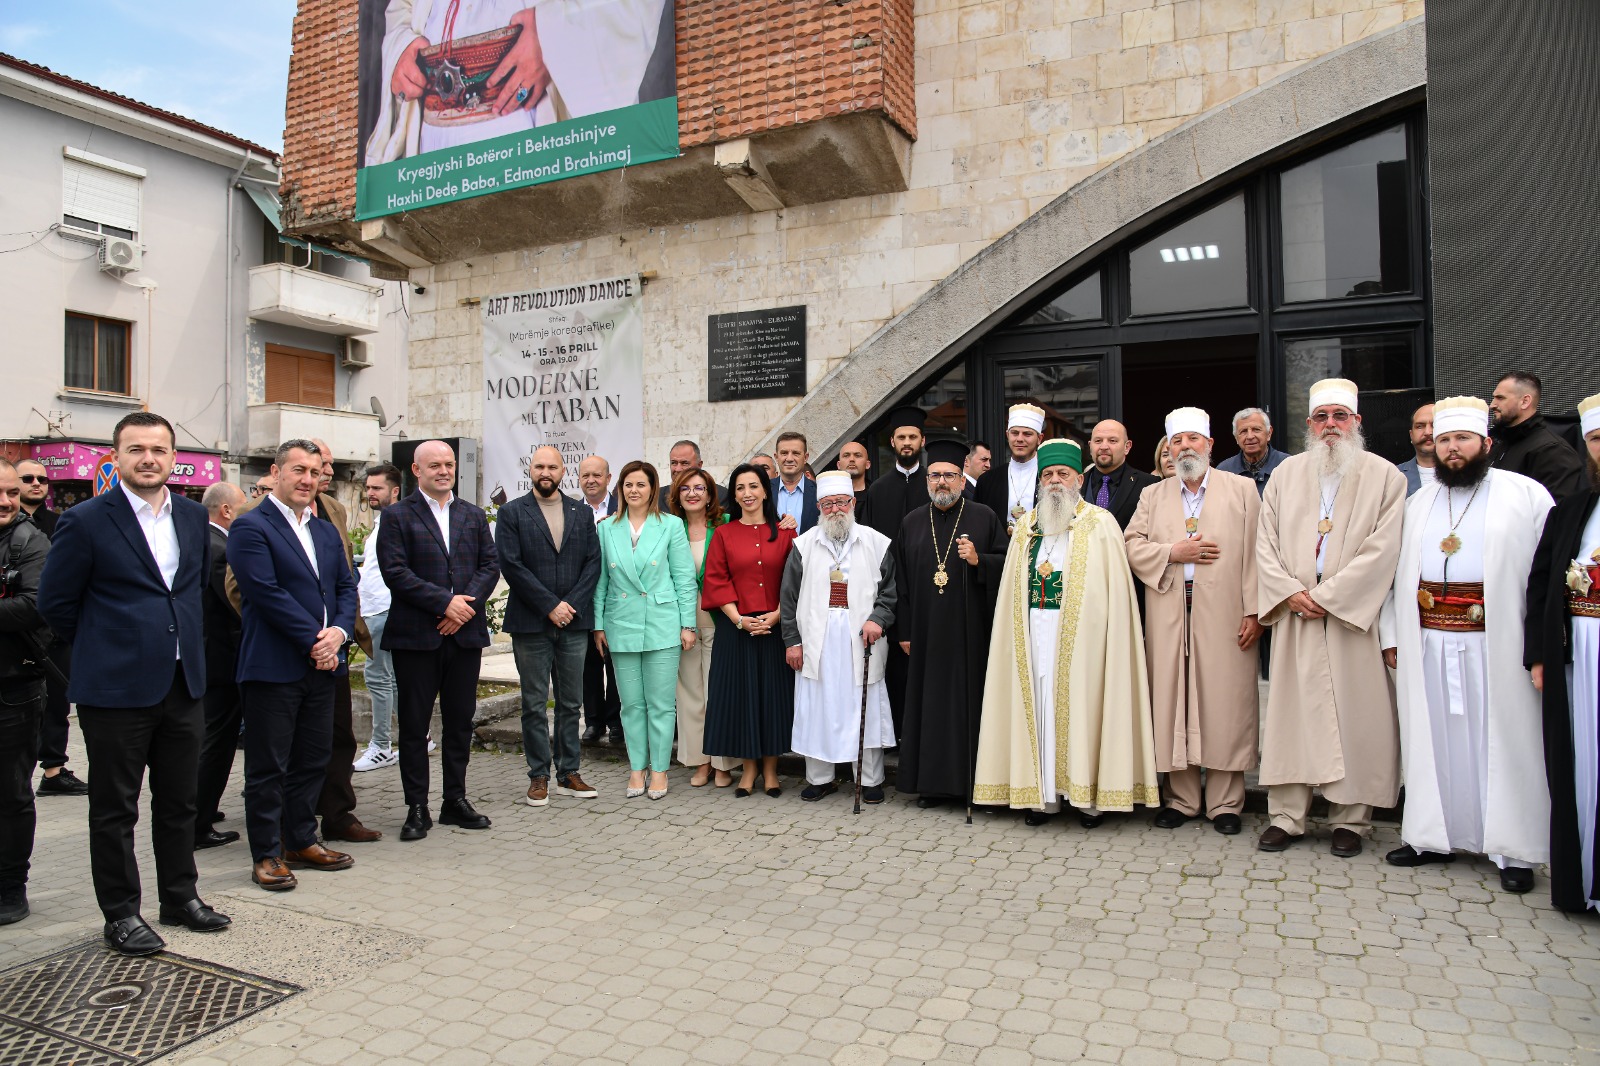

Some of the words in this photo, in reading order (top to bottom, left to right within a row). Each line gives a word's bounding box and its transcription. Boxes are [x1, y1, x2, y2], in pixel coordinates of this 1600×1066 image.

[398, 156, 463, 183] Kryegjyshi
[467, 148, 514, 166] Botëror
[517, 142, 521, 156] i
[525, 124, 617, 154] Bektashinjve
[387, 188, 422, 209] Haxhi
[426, 183, 458, 200] Dede
[461, 176, 500, 194] Baba,
[504, 163, 561, 184] Edmond
[564, 145, 631, 173] Brahimaj
[487, 297, 509, 317] ART
[512, 286, 586, 313] REVOLUTION
[589, 278, 633, 302] DANCE
[552, 319, 615, 336] koreografike)
[717, 321, 736, 329] TEATRI
[738, 319, 763, 327] SKAMPA
[768, 315, 796, 324] ELBASAN
[521, 350, 531, 359] 14
[538, 348, 547, 357] 15
[556, 345, 566, 354] 16
[569, 342, 598, 353] PRILL
[540, 357, 556, 366] ORA
[558, 355, 578, 364] 19.00
[486, 367, 599, 400] MODERNE
[521, 412, 538, 426] ME
[537, 394, 621, 424] TABAN
[561, 441, 586, 452] ZENA
